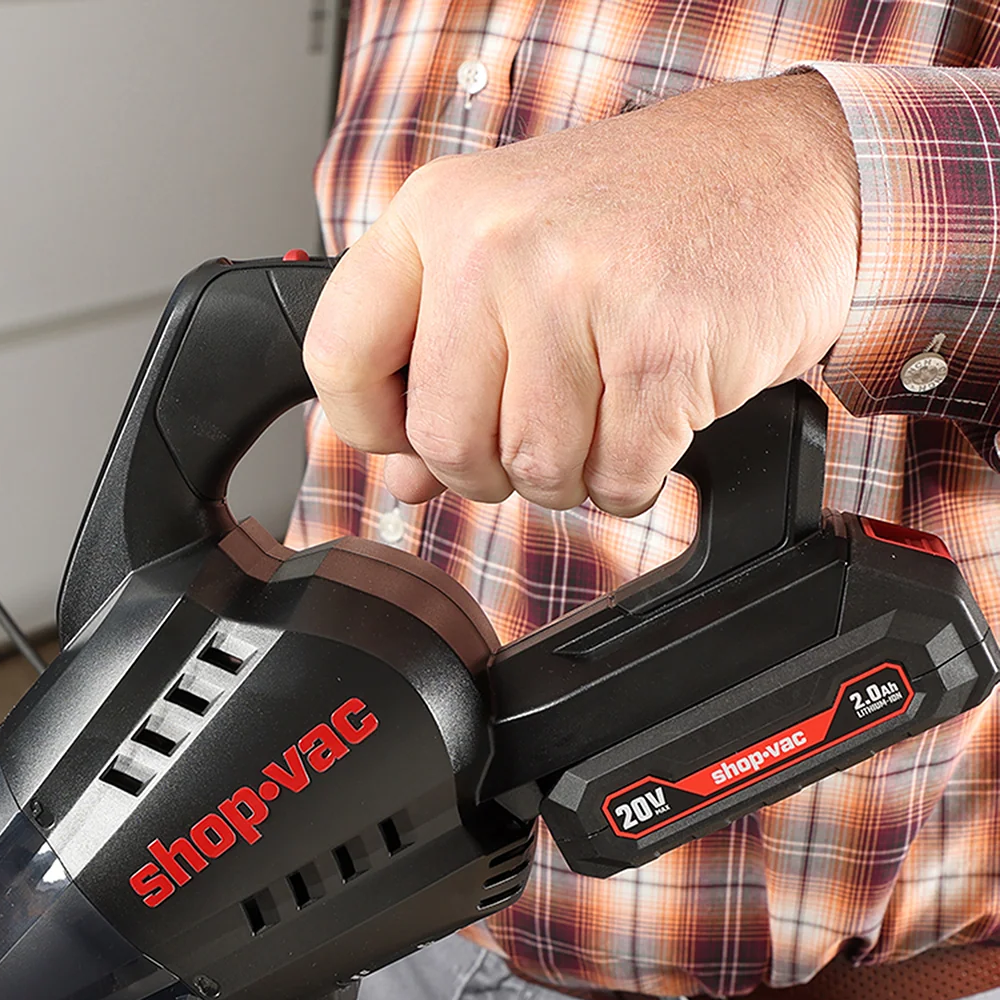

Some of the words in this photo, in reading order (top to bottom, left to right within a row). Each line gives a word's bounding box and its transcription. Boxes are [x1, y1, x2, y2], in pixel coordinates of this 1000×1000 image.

[849, 681, 899, 710] 2.0Ah
[856, 691, 903, 718] LITHIUM-ION
[614, 786, 666, 830] 20V
